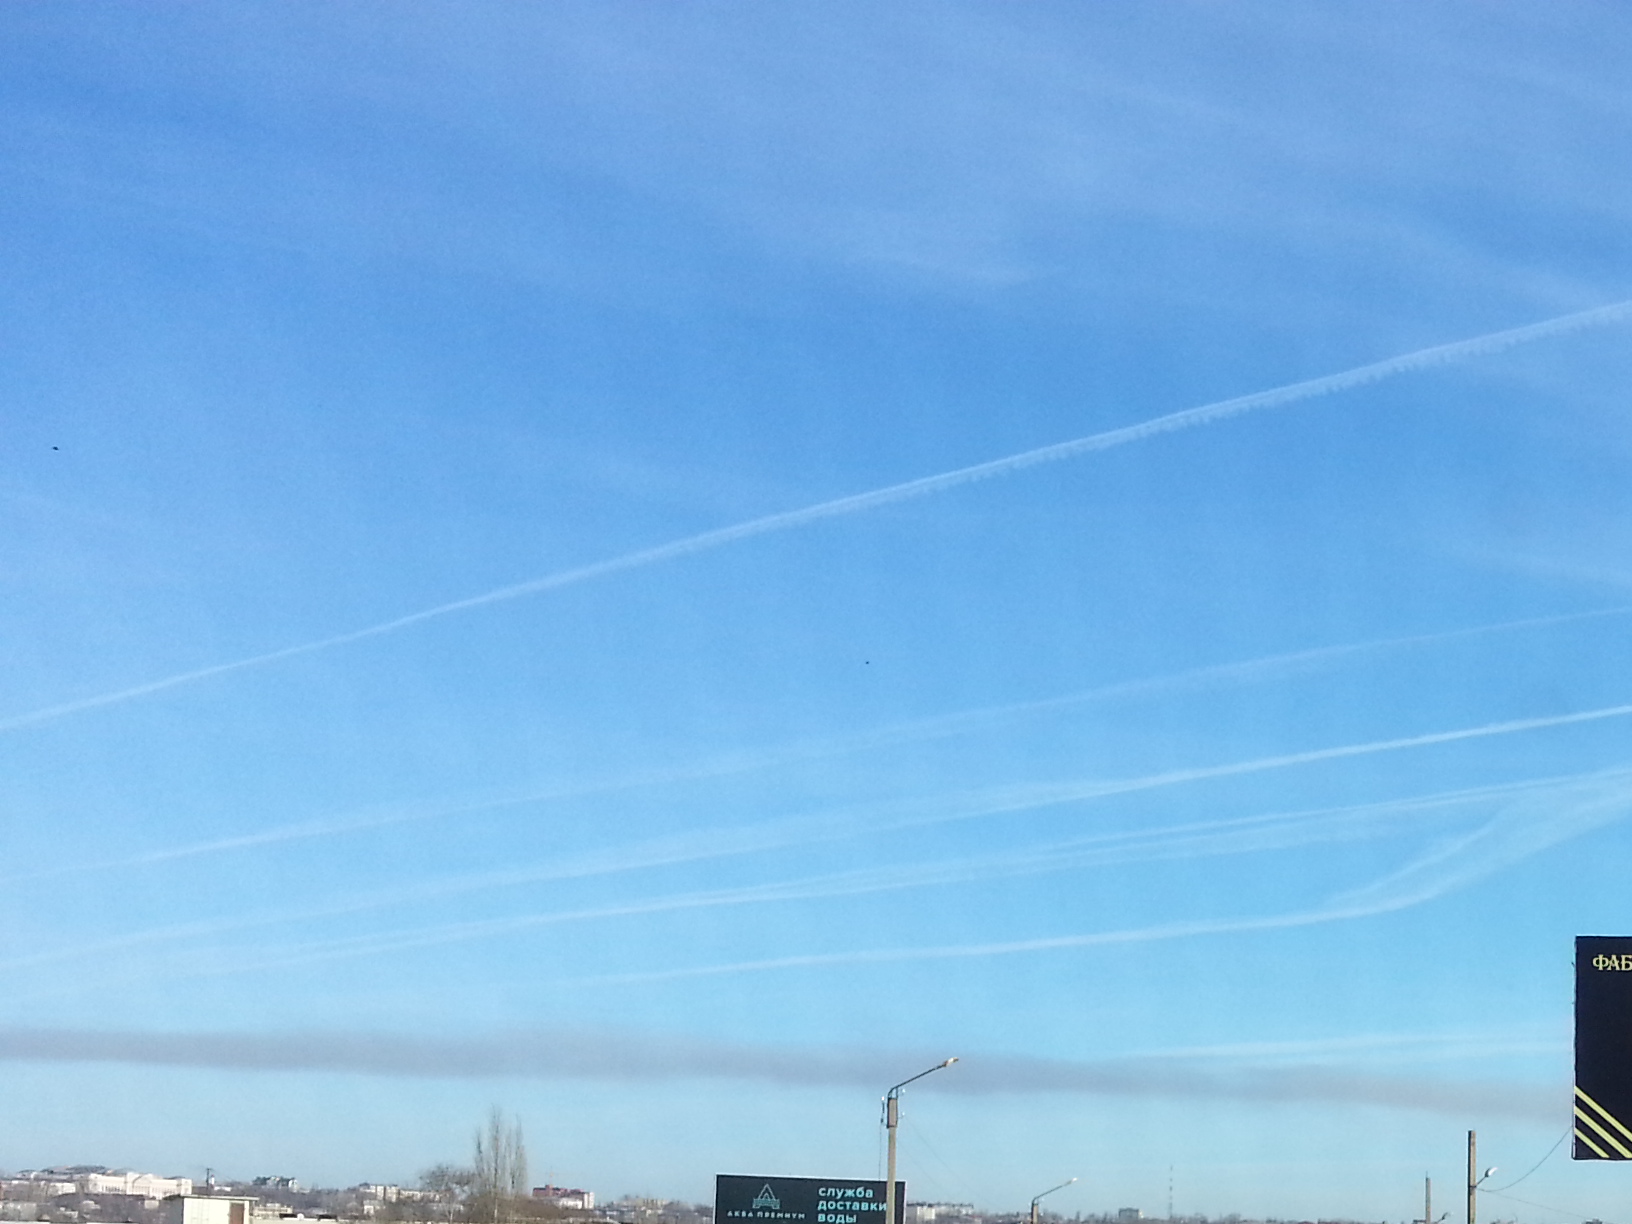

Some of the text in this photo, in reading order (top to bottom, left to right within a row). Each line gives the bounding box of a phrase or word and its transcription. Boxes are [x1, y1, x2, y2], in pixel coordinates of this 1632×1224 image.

[818, 1186, 874, 1200] служба
[817, 1200, 887, 1213] доставки
[727, 1210, 806, 1220] АКВА ПРЕМИУМ
[817, 1212, 857, 1224] воды
